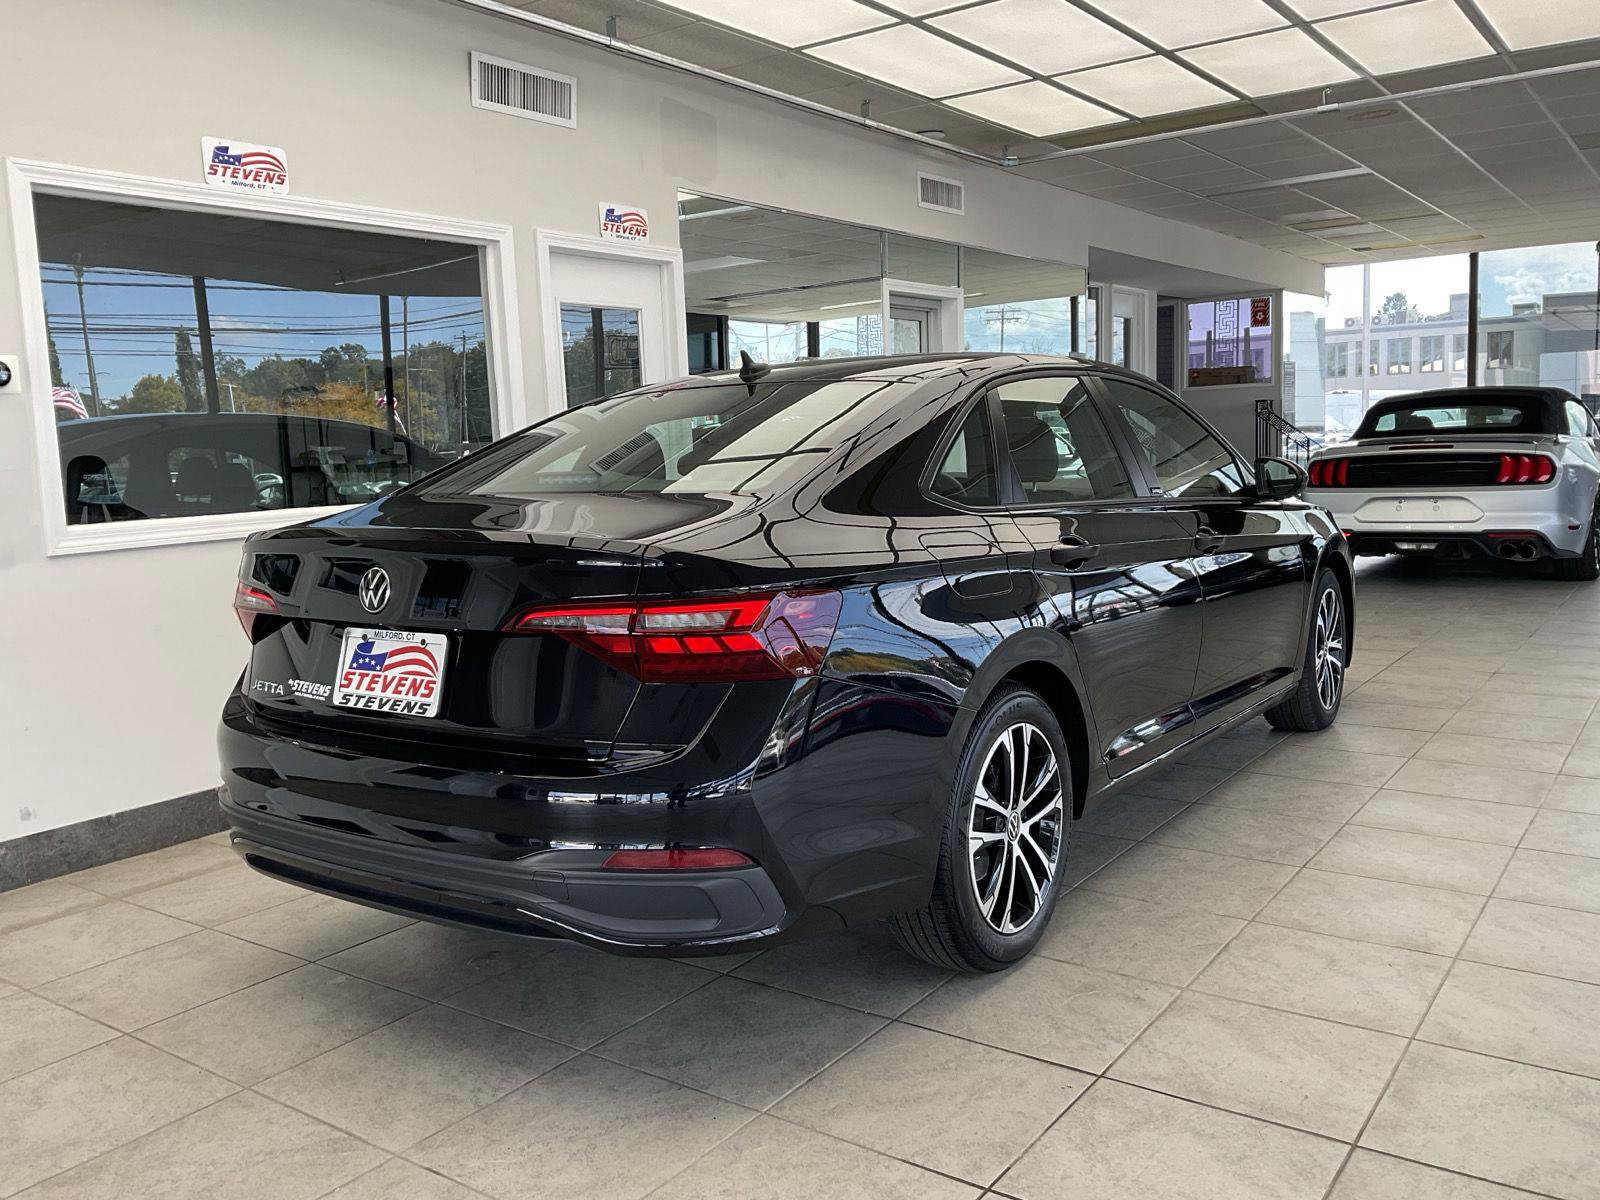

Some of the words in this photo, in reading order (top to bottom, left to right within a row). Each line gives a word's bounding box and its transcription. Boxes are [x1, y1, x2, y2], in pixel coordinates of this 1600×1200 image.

[207, 164, 287, 185] STEVENS
[231, 180, 255, 188] Milford,
[602, 222, 648, 237] STEVENS
[406, 633, 416, 641] CT
[251, 680, 284, 695] JETTA
[291, 679, 332, 697] STEVENS
[340, 671, 437, 699] STEVENS
[338, 693, 432, 716] STEVENS
